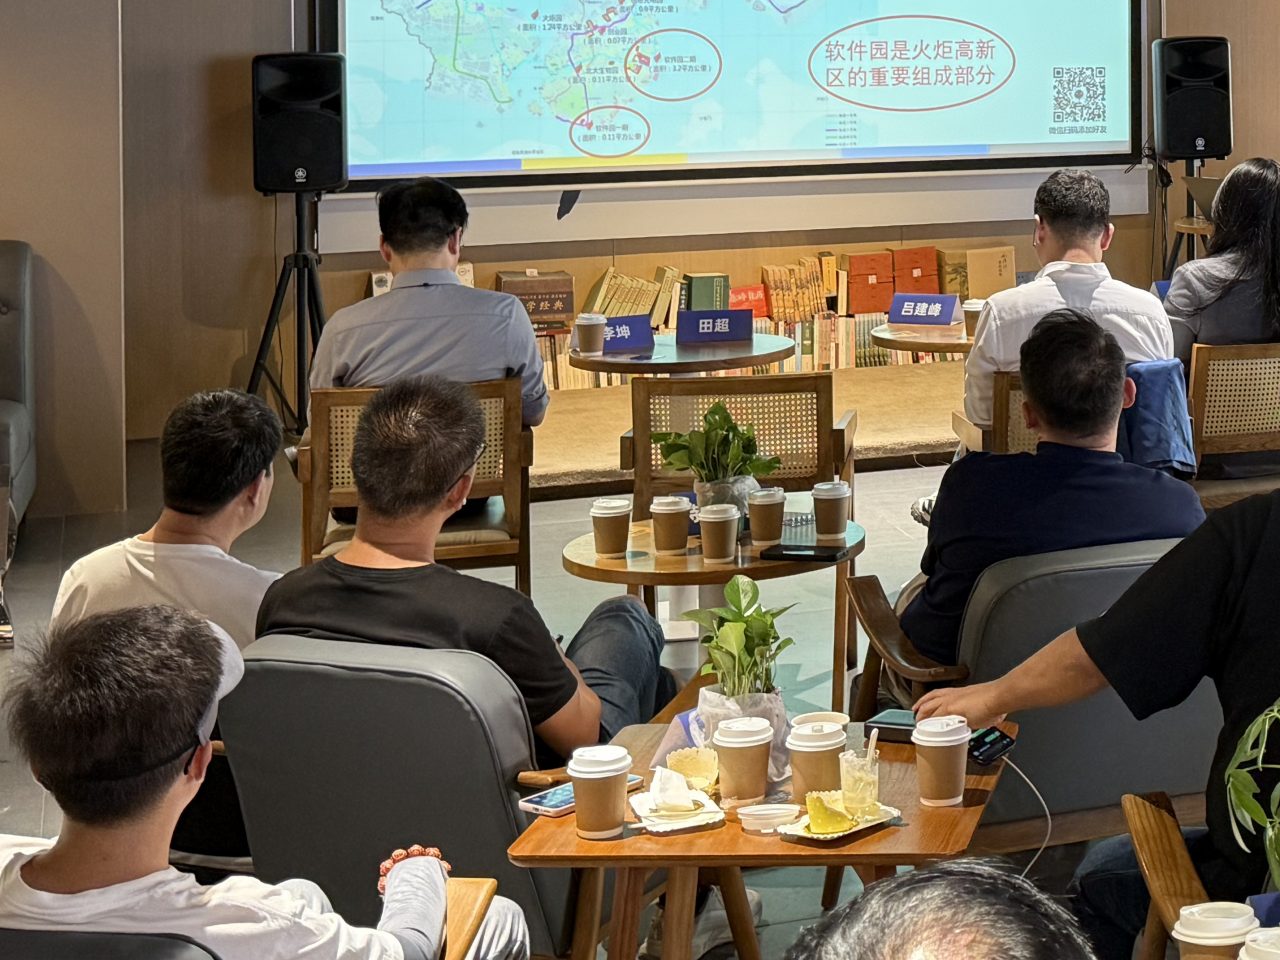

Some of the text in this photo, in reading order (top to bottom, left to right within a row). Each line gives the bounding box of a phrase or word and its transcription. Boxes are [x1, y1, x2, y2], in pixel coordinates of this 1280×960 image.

[825, 38, 996, 62] 软件园是火炬高新
[826, 65, 996, 88] 区的重要组成部分
[901, 301, 942, 317] 吕建峰
[603, 324, 631, 341] 李坤
[698, 318, 730, 333] 田超
